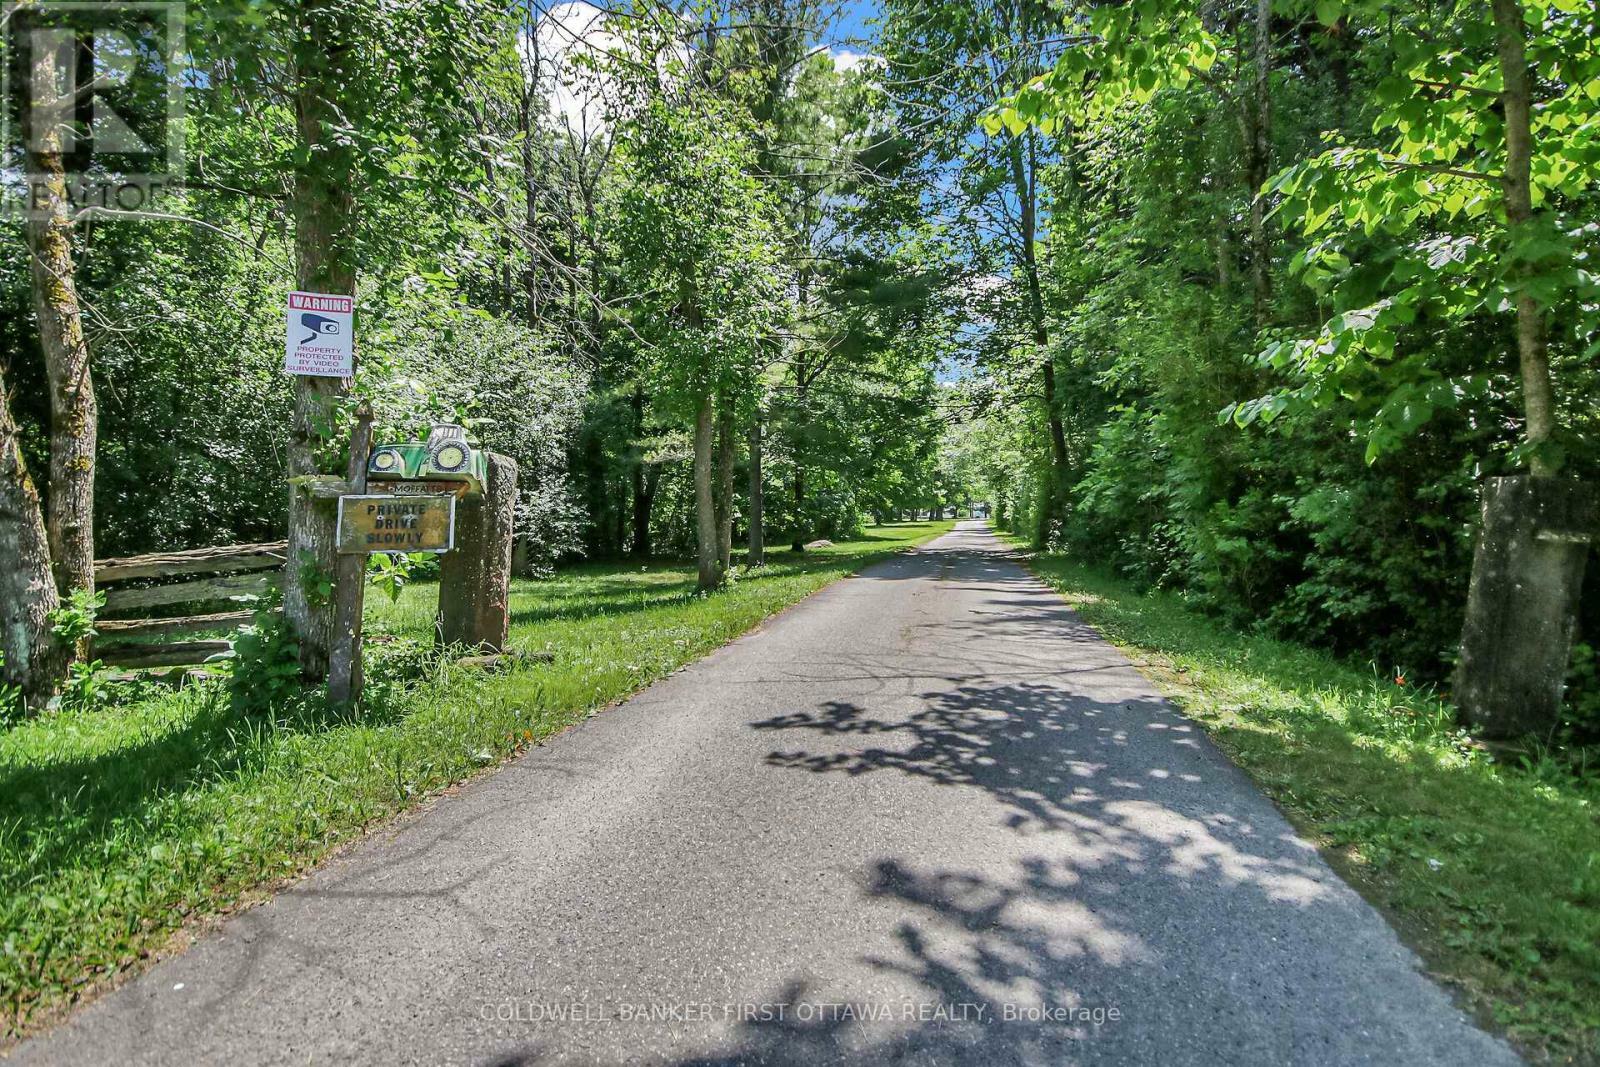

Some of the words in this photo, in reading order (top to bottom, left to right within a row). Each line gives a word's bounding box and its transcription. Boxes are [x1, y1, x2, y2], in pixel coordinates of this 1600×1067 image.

[291, 295, 349, 312] WARNING
[297, 345, 342, 354] PROPERTY
[294, 352, 344, 361] PROTECTED
[286, 365, 350, 375] SURVEILLANCE
[367, 504, 426, 515] PRIVATE
[375, 518, 418, 529] DRIVE
[366, 532, 424, 544] SLOWLY
